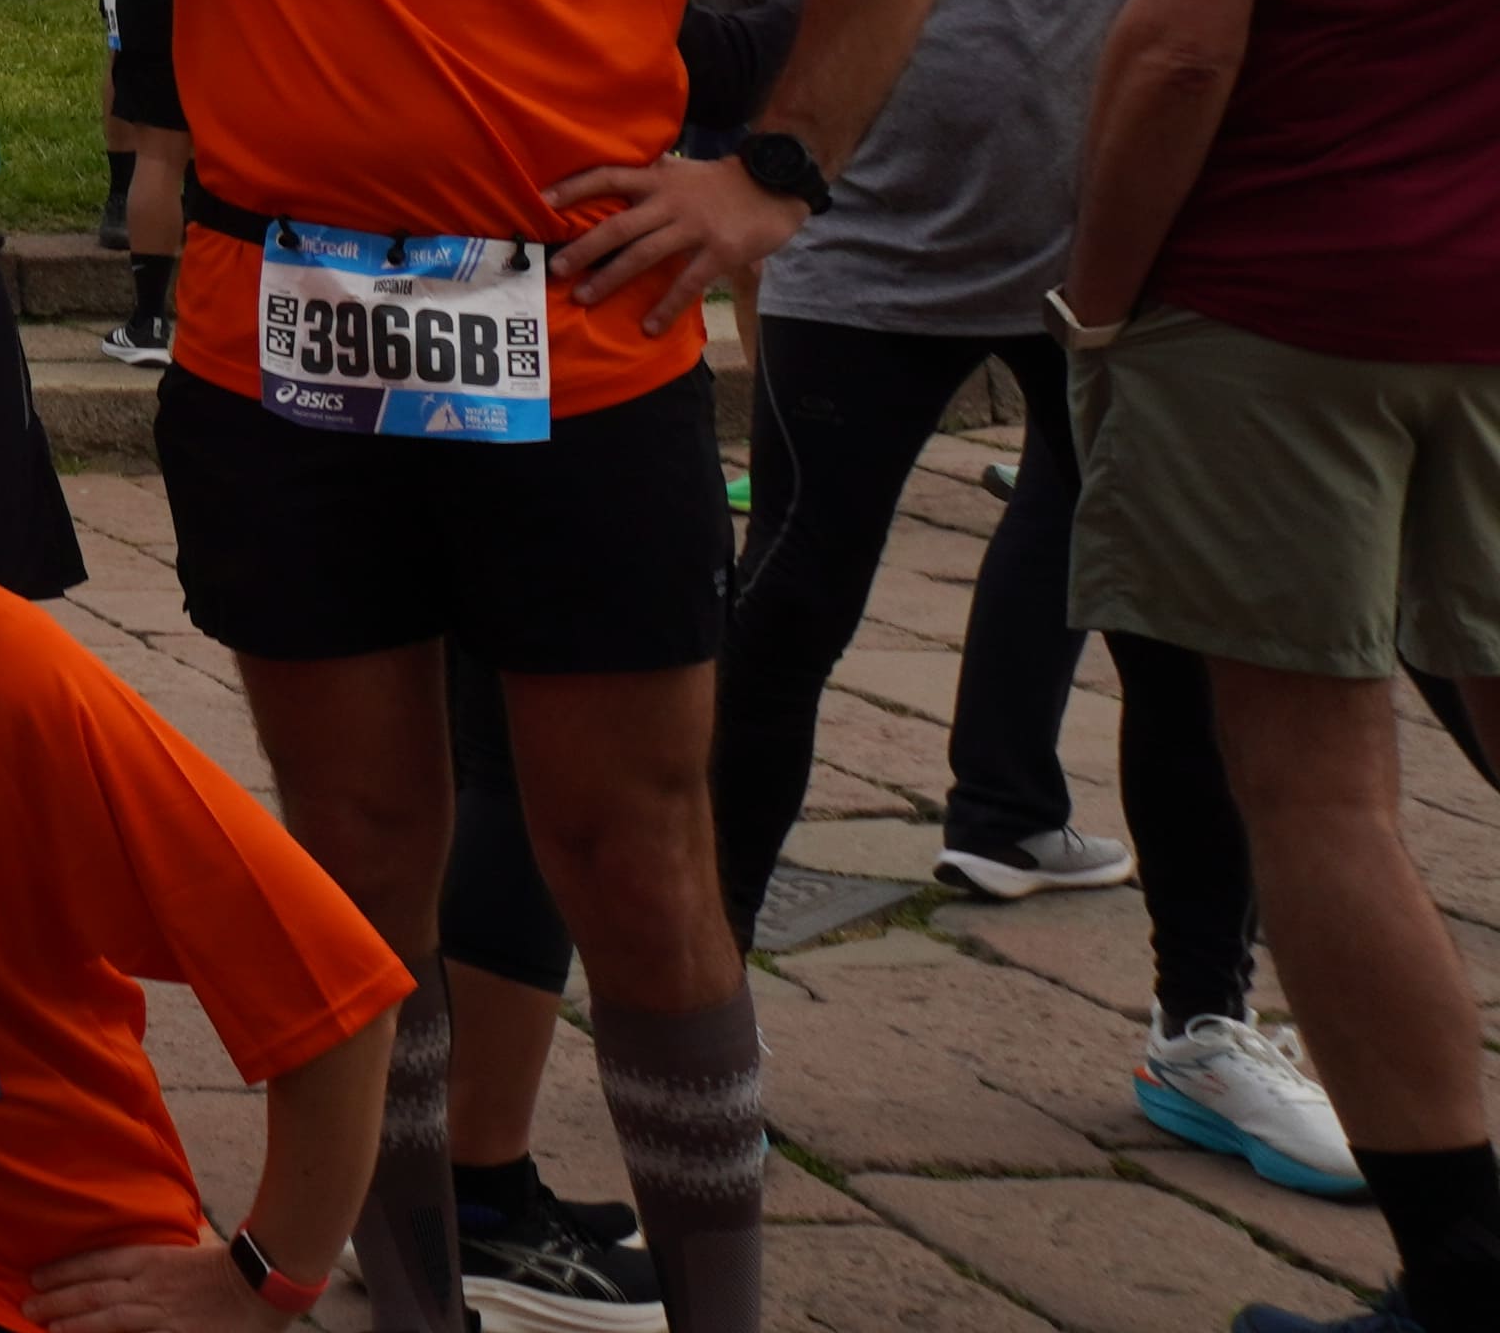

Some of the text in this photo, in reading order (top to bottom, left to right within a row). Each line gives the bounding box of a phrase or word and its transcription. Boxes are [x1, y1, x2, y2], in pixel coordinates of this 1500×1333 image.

[409, 248, 453, 262] RELAY
[300, 299, 501, 387] 3966B
[296, 390, 344, 412] asics
